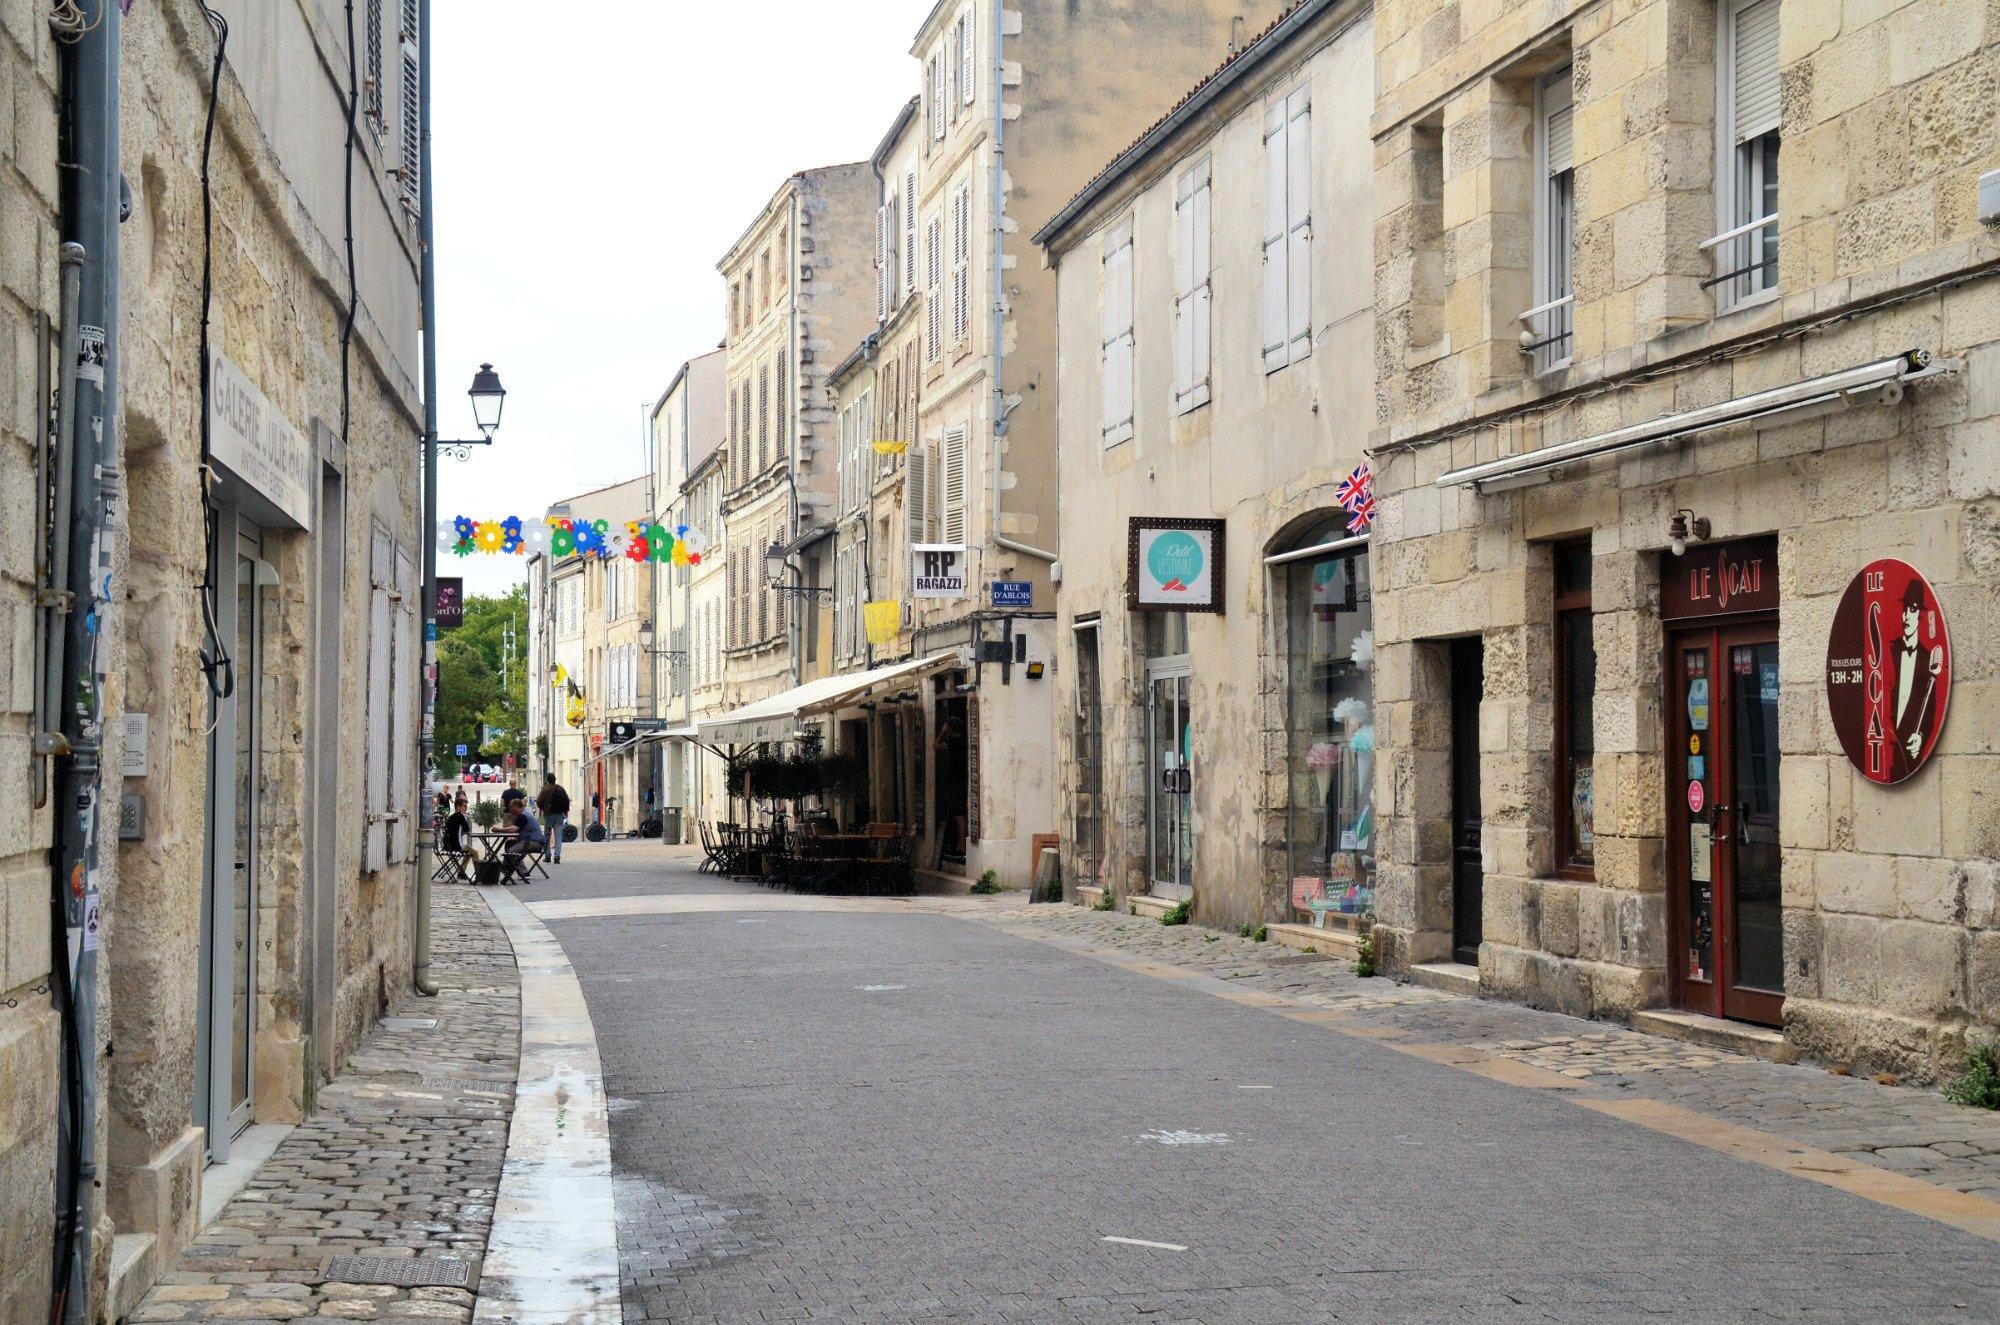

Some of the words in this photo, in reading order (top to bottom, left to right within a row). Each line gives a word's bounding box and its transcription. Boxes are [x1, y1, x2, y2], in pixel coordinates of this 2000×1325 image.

[213, 356, 261, 451] GALERIE
[924, 551, 955, 577] RP
[916, 577, 962, 590] RAGAZZI
[1003, 583, 1020, 591] RUE
[1690, 566, 1711, 600] LE
[1718, 548, 1763, 608] SCAT
[1866, 571, 1884, 592] LE
[994, 591, 1030, 599] D'ABLOIS
[1830, 671, 1846, 684] 13H
[1851, 670, 1863, 683] 2H
[1867, 601, 1884, 773] SCAT
